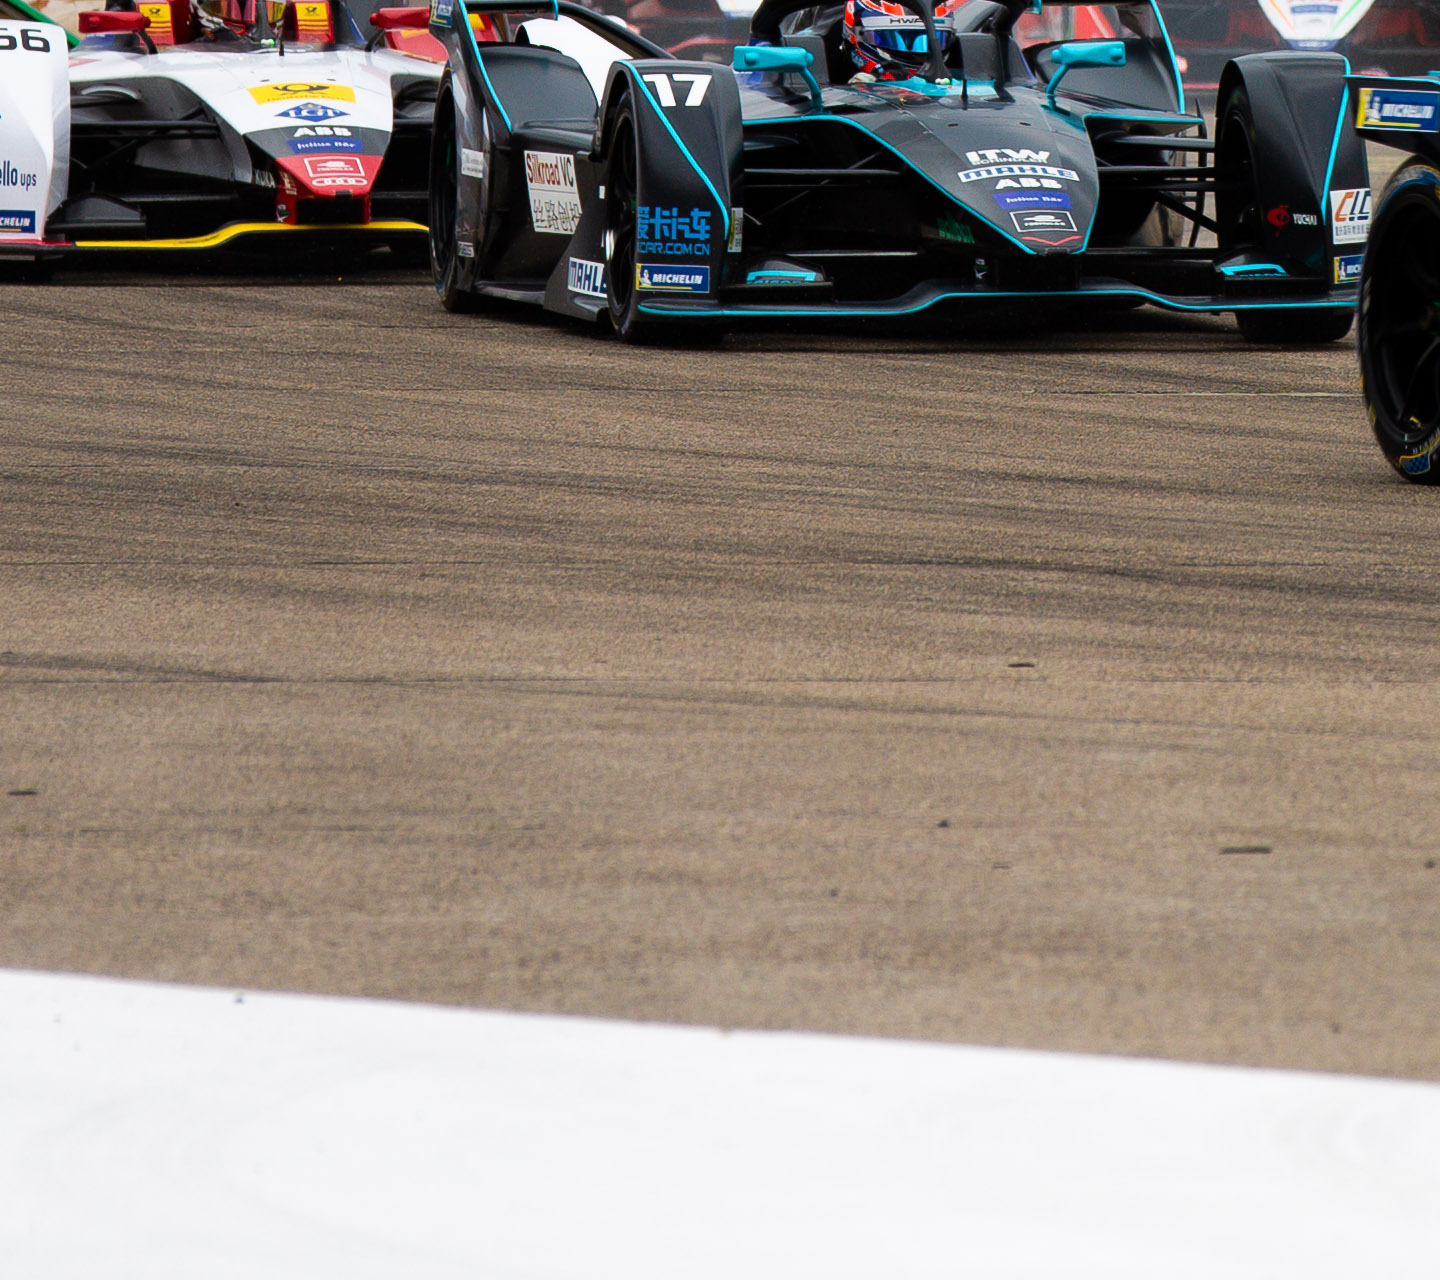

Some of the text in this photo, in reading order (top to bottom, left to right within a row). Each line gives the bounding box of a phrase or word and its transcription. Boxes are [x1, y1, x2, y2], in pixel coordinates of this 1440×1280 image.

[642, 73, 713, 107] 17
[293, 126, 352, 138] ABB
[965, 148, 1050, 162] ITW
[527, 153, 575, 188] Silkroad VC
[963, 167, 1076, 181] MAHLE
[20, 174, 36, 191] ups
[995, 177, 1063, 190] ABB
[569, 260, 606, 294] MAHL
[652, 274, 703, 285] MICHELIN
